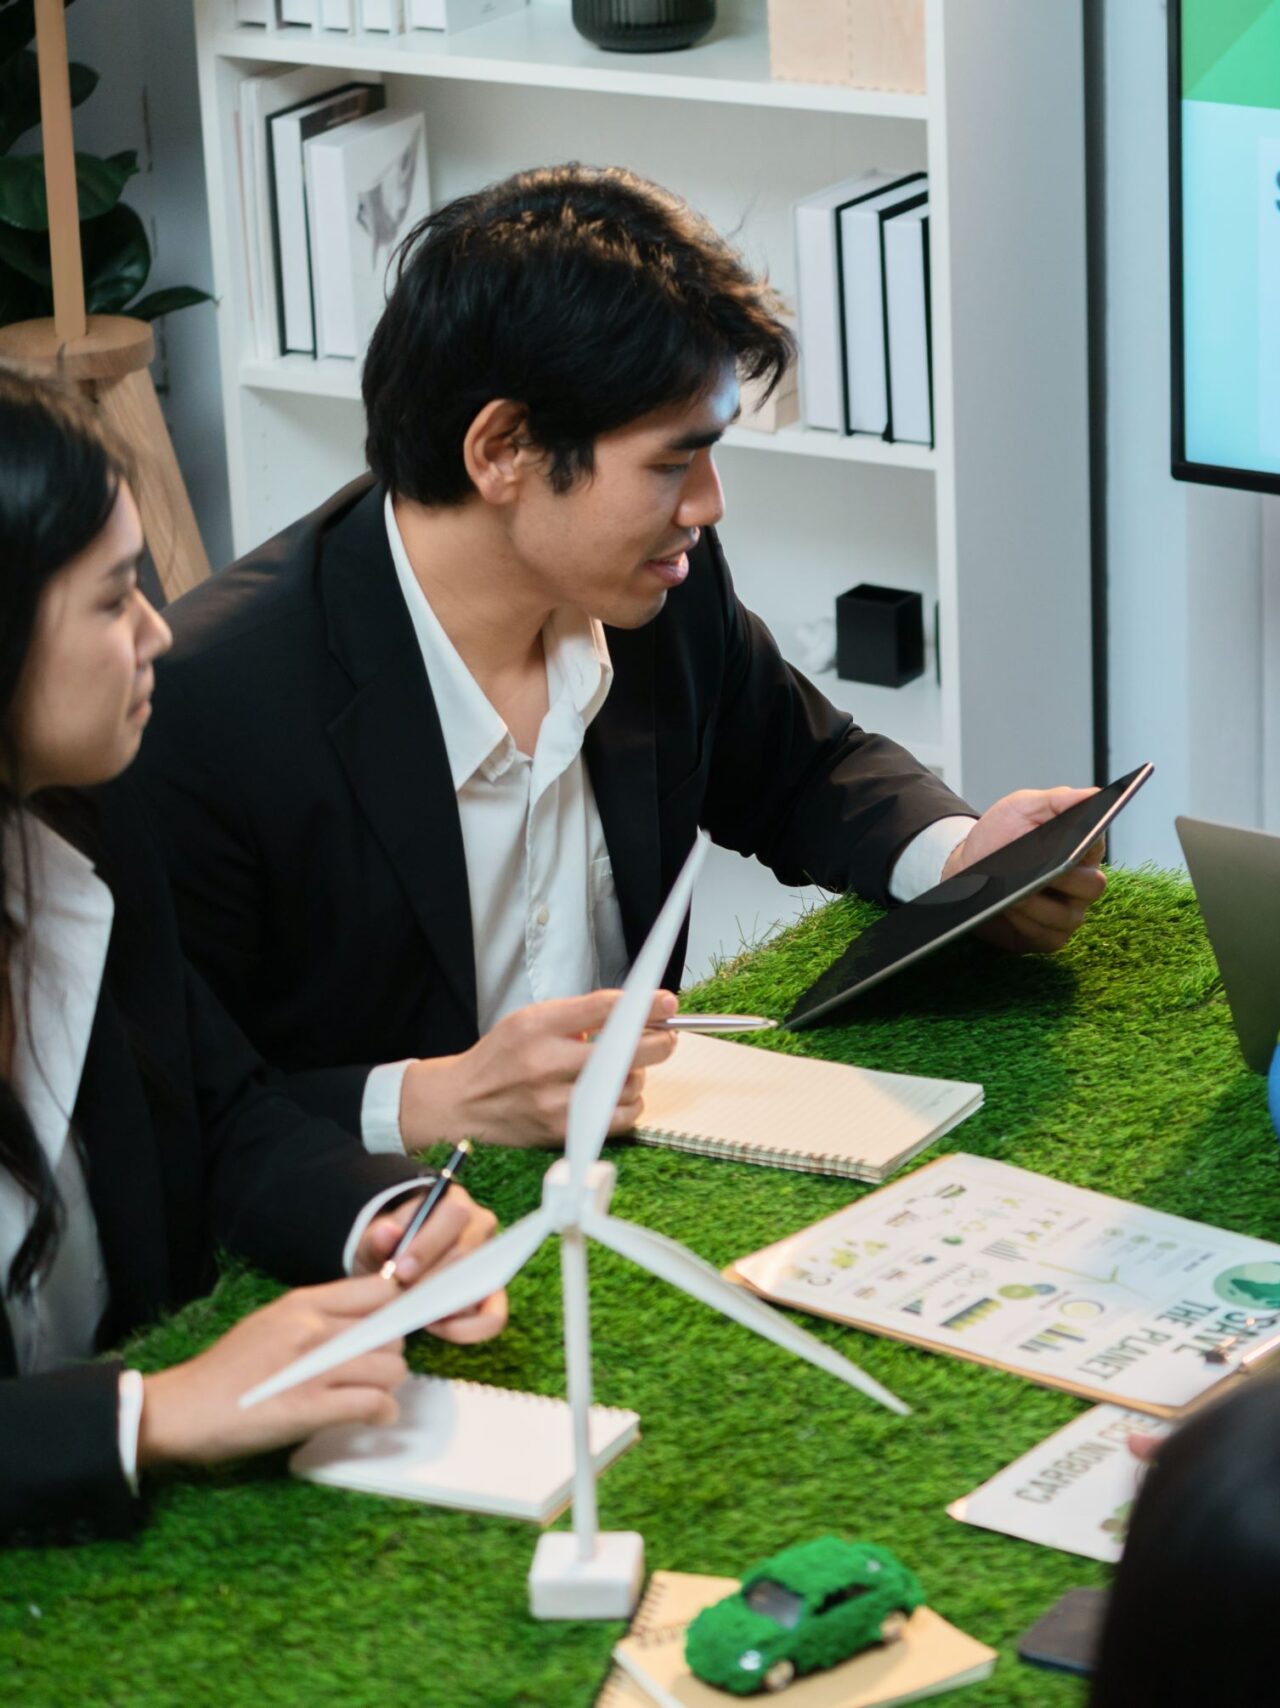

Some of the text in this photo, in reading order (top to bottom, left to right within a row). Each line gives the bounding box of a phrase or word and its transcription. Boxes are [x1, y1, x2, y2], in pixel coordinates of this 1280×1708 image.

[1076, 1299, 1221, 1382] THE PLANET
[1013, 1440, 1118, 1505] CARBON
